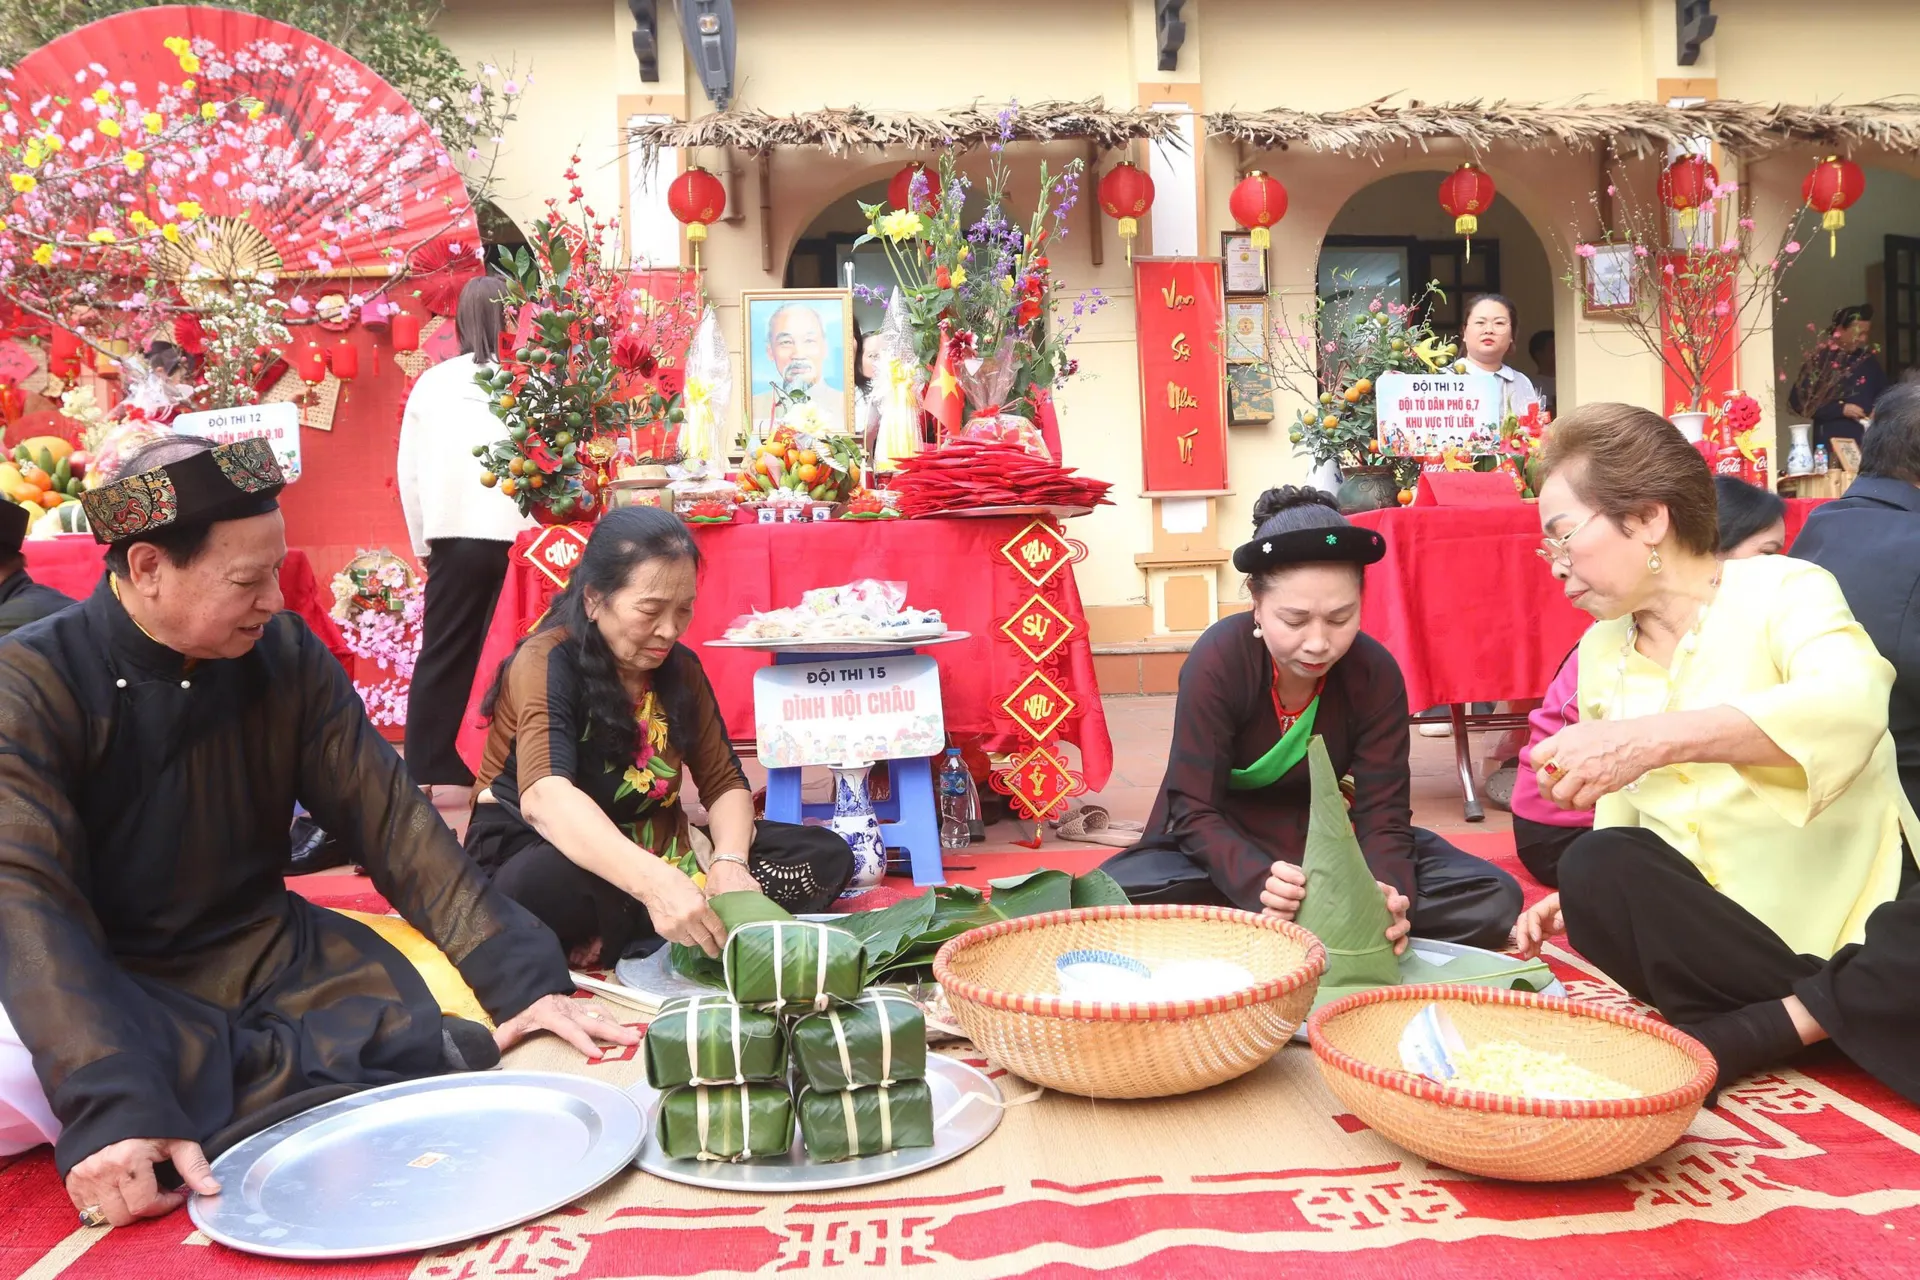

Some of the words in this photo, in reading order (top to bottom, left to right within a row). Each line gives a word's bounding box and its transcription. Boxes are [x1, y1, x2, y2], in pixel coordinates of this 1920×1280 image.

[1413, 380, 1431, 394] ĐỘI
[1434, 382, 1449, 392] THI
[1453, 382, 1464, 392] 12
[1398, 397, 1413, 413] ĐỘI
[1428, 396, 1444, 411] DÂN
[208, 415, 228, 428] ĐỘI
[231, 414, 246, 425] THI
[250, 413, 261, 422] 12
[1406, 416, 1422, 428] KHU
[1425, 416, 1442, 430] VỰC
[1457, 414, 1474, 428] LIÊN
[545, 538, 579, 568] CHÚC
[1020, 538, 1052, 568] VẠN
[1022, 613, 1051, 642] SỰ
[806, 668, 835, 686] ĐỘI
[839, 668, 863, 682] THI
[868, 666, 887, 679] 15
[782, 693, 826, 721] ĐÌNH
[831, 689, 862, 721] NỘI
[867, 685, 916, 715] CHÂU
[1023, 693, 1055, 721] NHƯ
